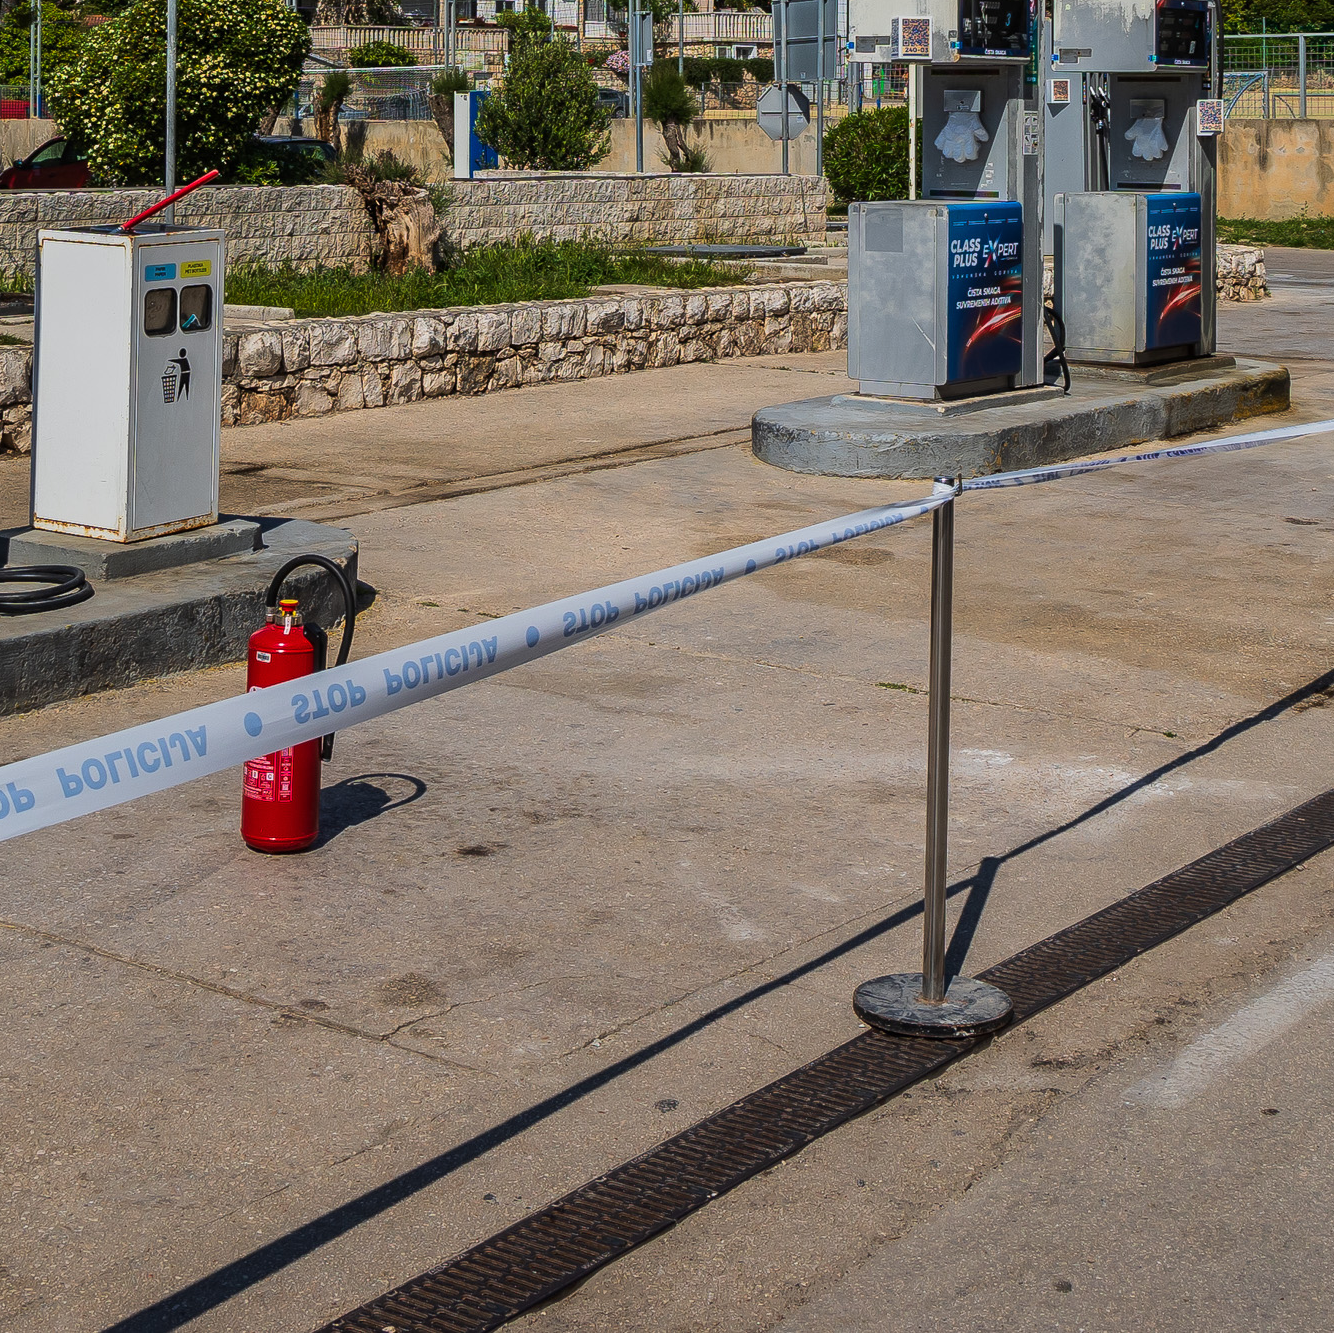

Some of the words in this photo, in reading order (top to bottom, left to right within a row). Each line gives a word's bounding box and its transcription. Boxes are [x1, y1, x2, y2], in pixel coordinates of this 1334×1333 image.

[1149, 225, 1170, 237] CLASS
[951, 238, 980, 253] CLASS
[1150, 238, 1168, 250] PLUS
[953, 253, 978, 267] PLUS
